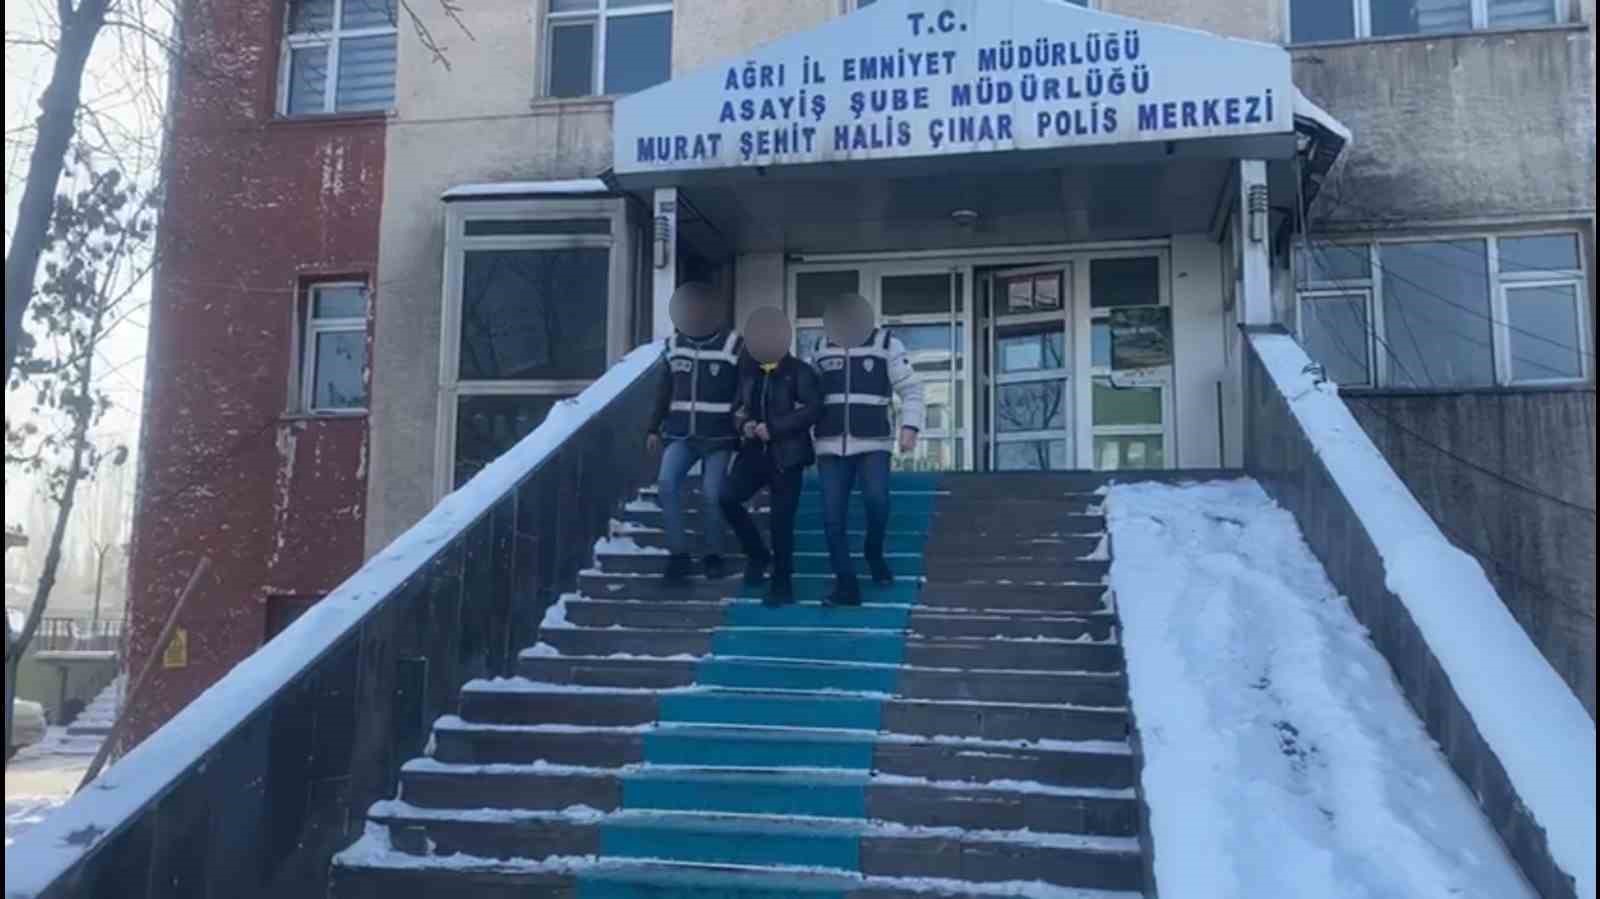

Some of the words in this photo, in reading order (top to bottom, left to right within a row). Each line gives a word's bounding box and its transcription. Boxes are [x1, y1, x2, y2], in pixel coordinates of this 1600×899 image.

[908, 10, 967, 36] T.C.
[725, 61, 785, 91] AĞRI
[803, 55, 825, 84] İL
[843, 47, 957, 82] EMNİYET
[978, 29, 1140, 72] MÜDÜRLÜĞÜ
[720, 89, 826, 122] ASAYİŞ
[850, 87, 929, 119] ŞUBE
[951, 64, 1150, 107] MÜDÜRLÜĞÜ
[636, 132, 722, 163] MURAT
[834, 115, 911, 151] HALİS
[929, 113, 1013, 148] ÇINAR
[1037, 101, 1118, 138] POLİS
[1138, 88, 1274, 131] MERKEZİ
